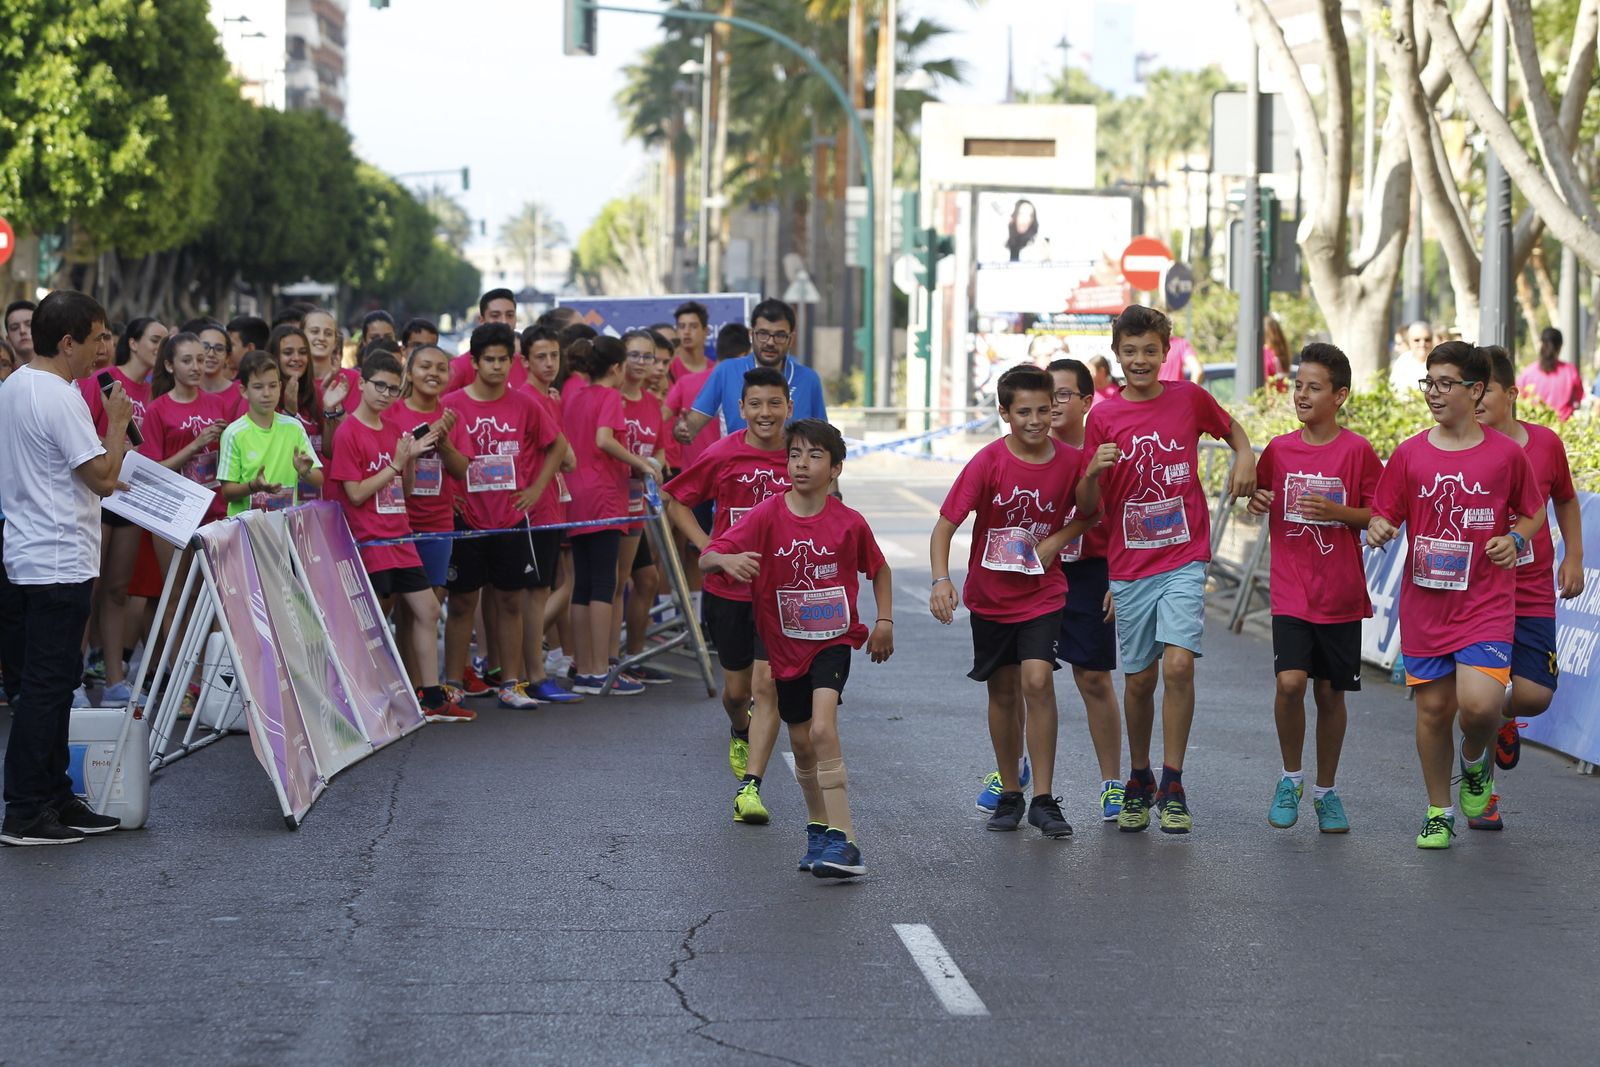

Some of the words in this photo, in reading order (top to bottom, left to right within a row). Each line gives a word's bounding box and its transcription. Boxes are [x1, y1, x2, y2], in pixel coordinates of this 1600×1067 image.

[1162, 465, 1172, 485] 4
[1460, 508, 1469, 529] 4
[1426, 553, 1467, 571] 1926
[800, 603, 844, 620] 2001
